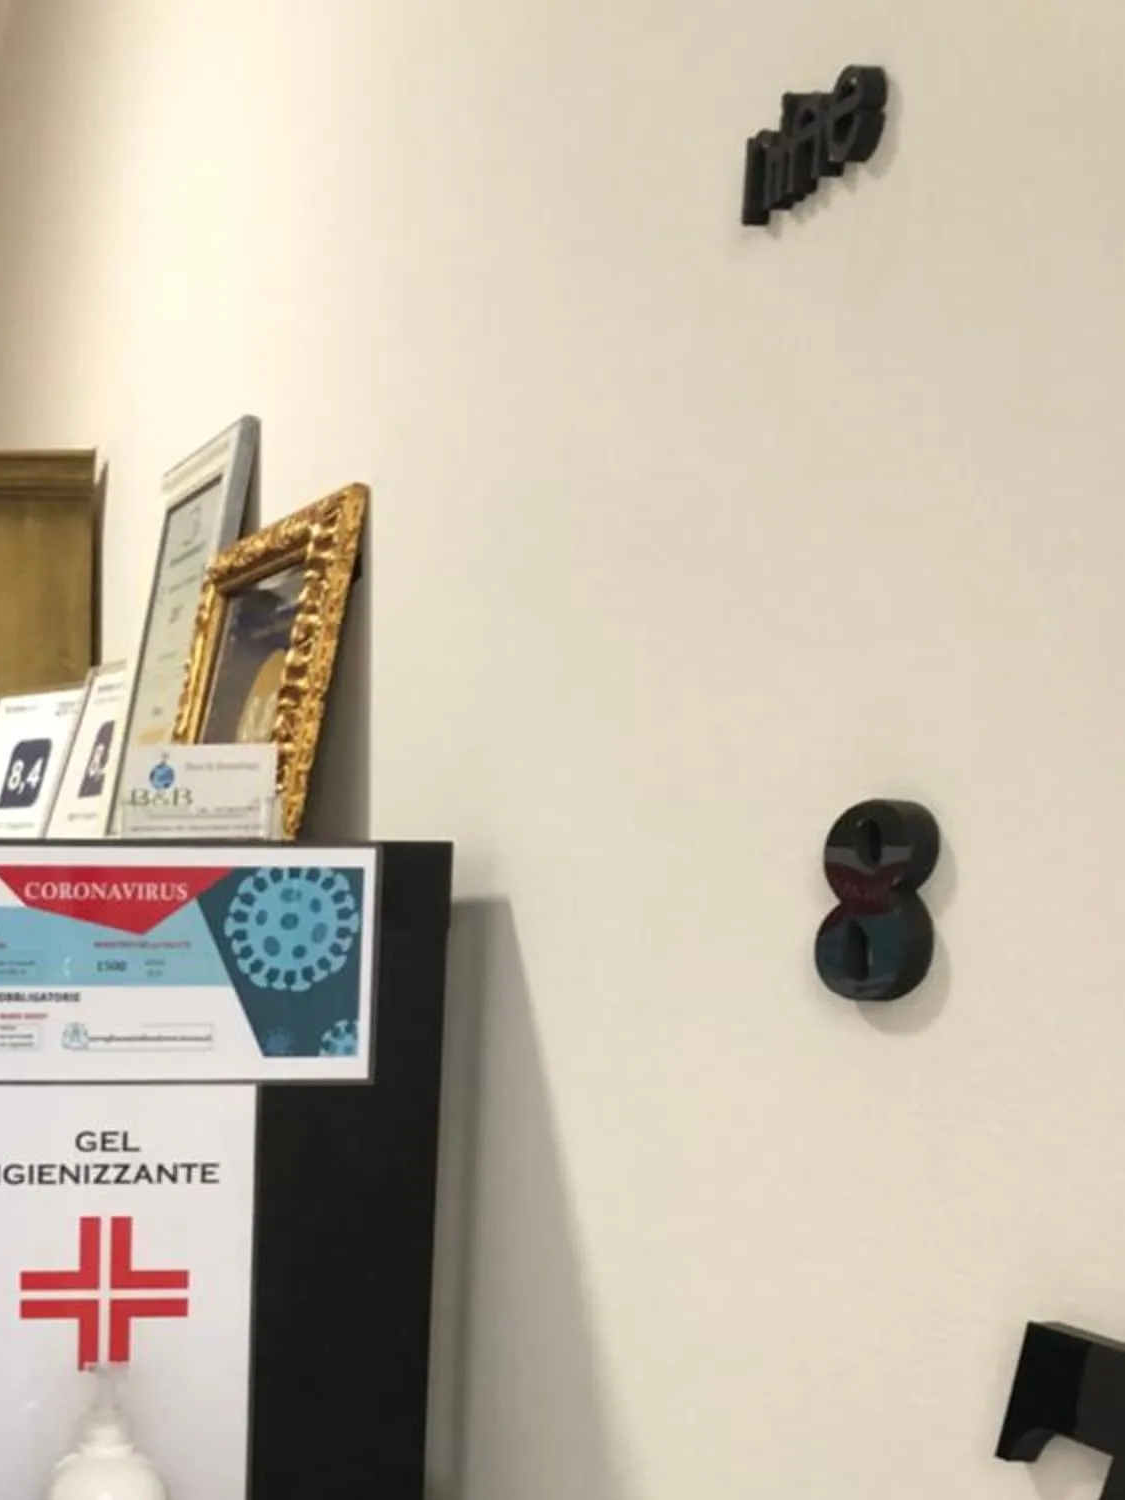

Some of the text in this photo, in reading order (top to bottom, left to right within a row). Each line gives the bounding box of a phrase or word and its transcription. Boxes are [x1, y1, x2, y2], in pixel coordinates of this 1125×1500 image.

[7, 757, 44, 795] 8,4
[130, 787, 193, 807] B&B
[25, 881, 189, 901] CORONAVIRUS
[815, 798, 939, 1001] 8
[75, 1131, 141, 1153] GEL
